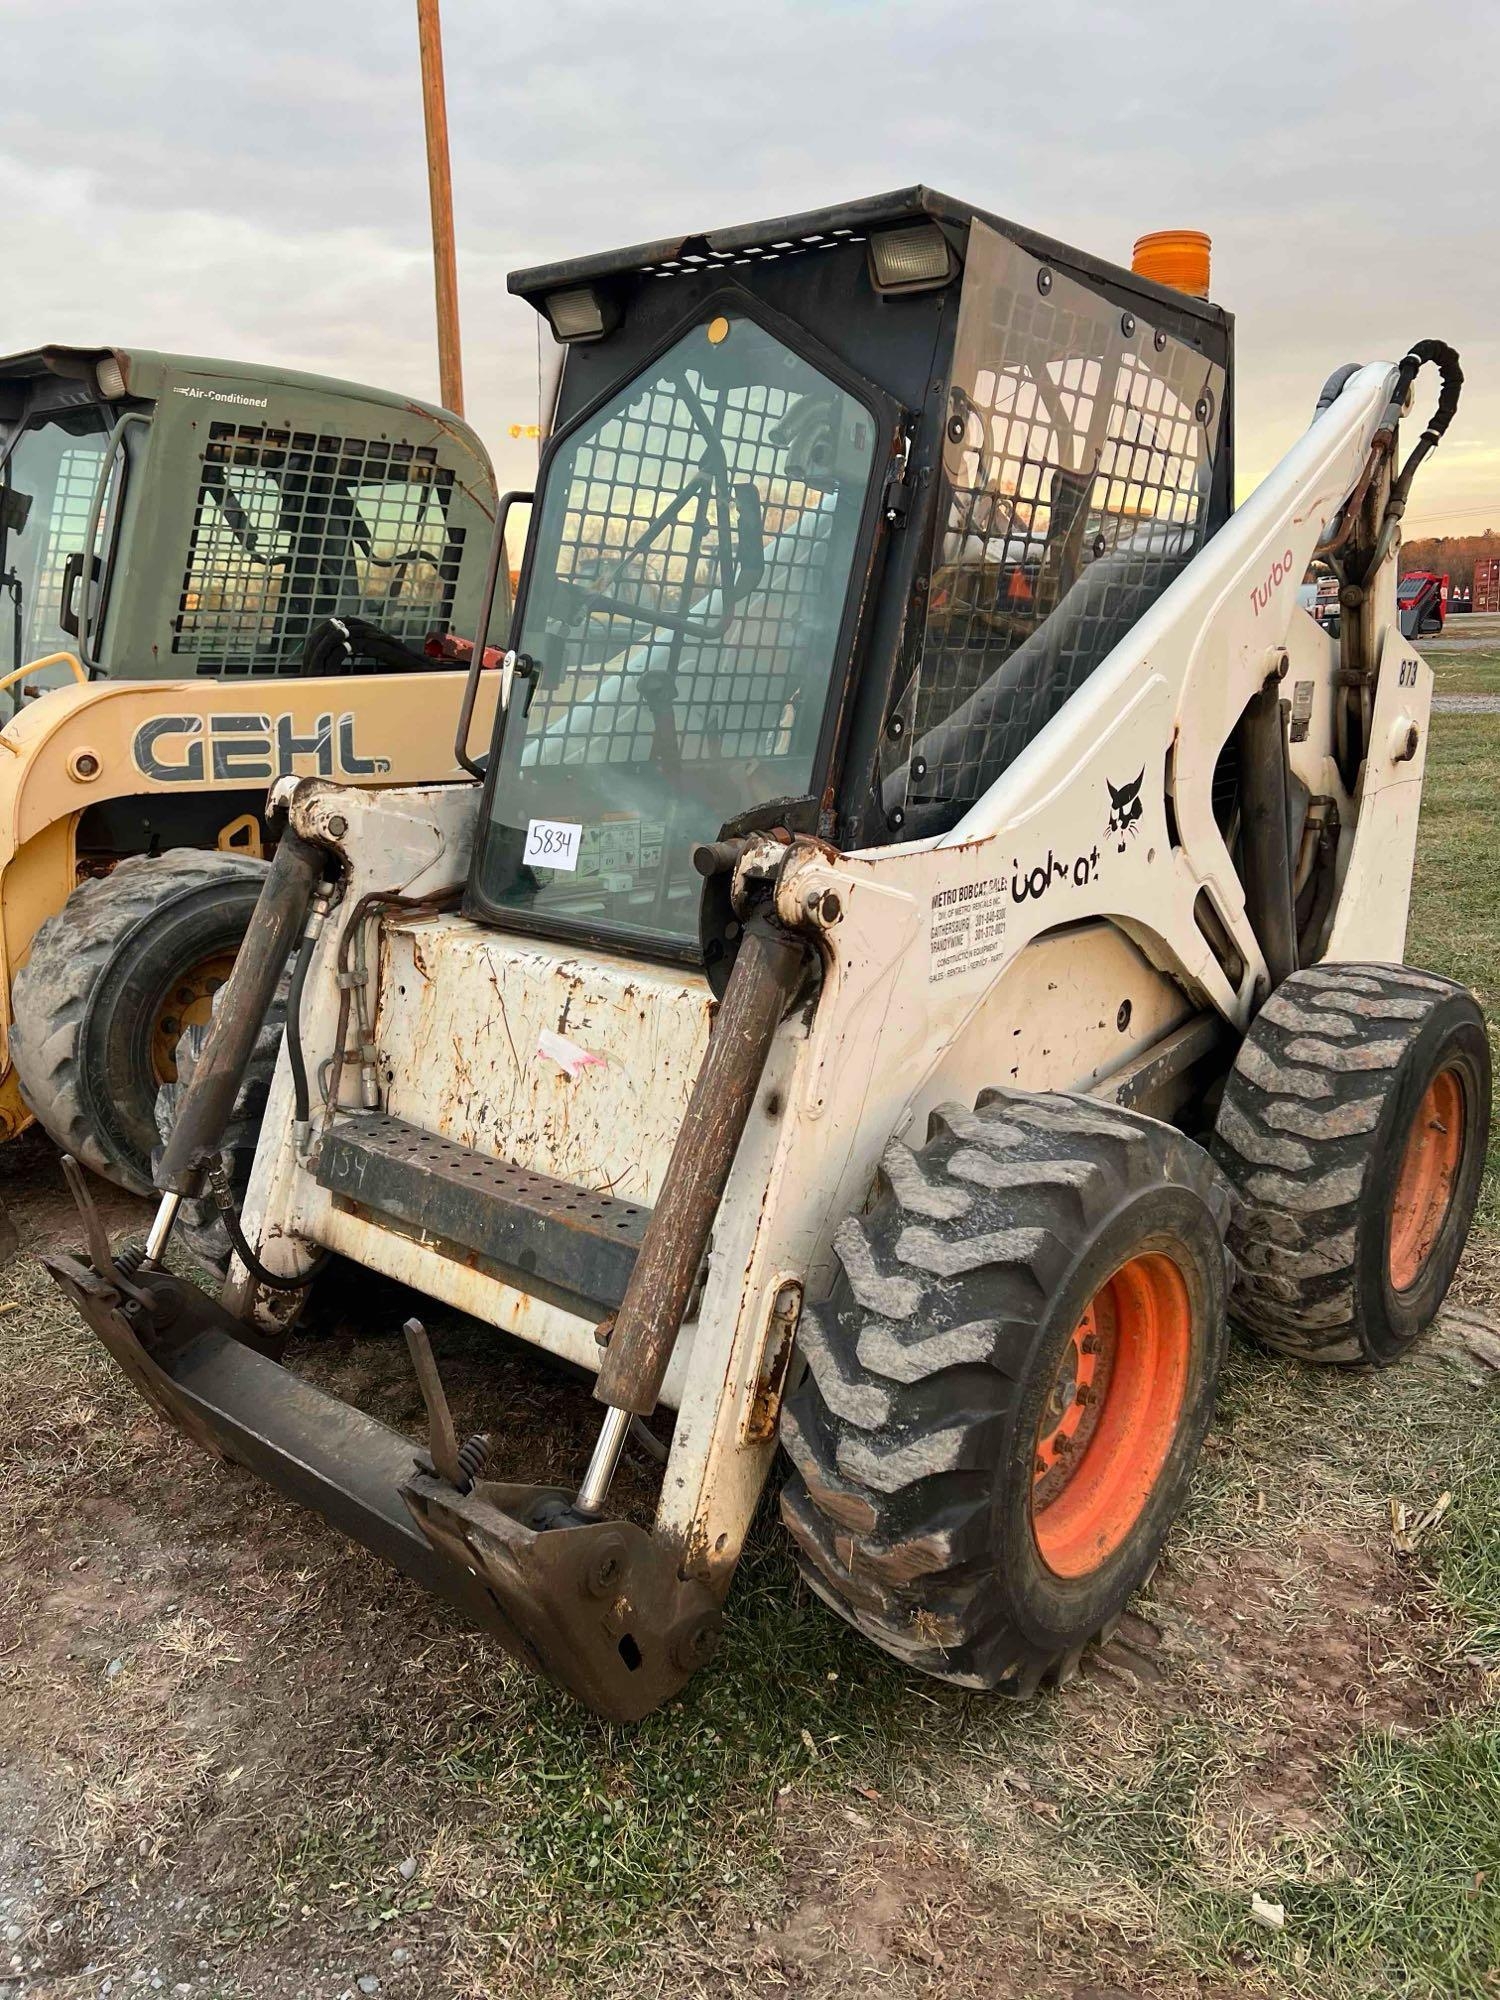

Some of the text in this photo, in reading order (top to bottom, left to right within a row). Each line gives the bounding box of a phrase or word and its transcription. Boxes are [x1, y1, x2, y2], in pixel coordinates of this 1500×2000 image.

[188, 387, 268, 408] Air-Conditioned
[1250, 549, 1293, 617] Turbo
[1399, 660, 1418, 686] 873
[131, 712, 377, 784] GEHL
[529, 824, 572, 857] 5834
[931, 889, 957, 909] METRO
[958, 881, 987, 902] BOBCAT
